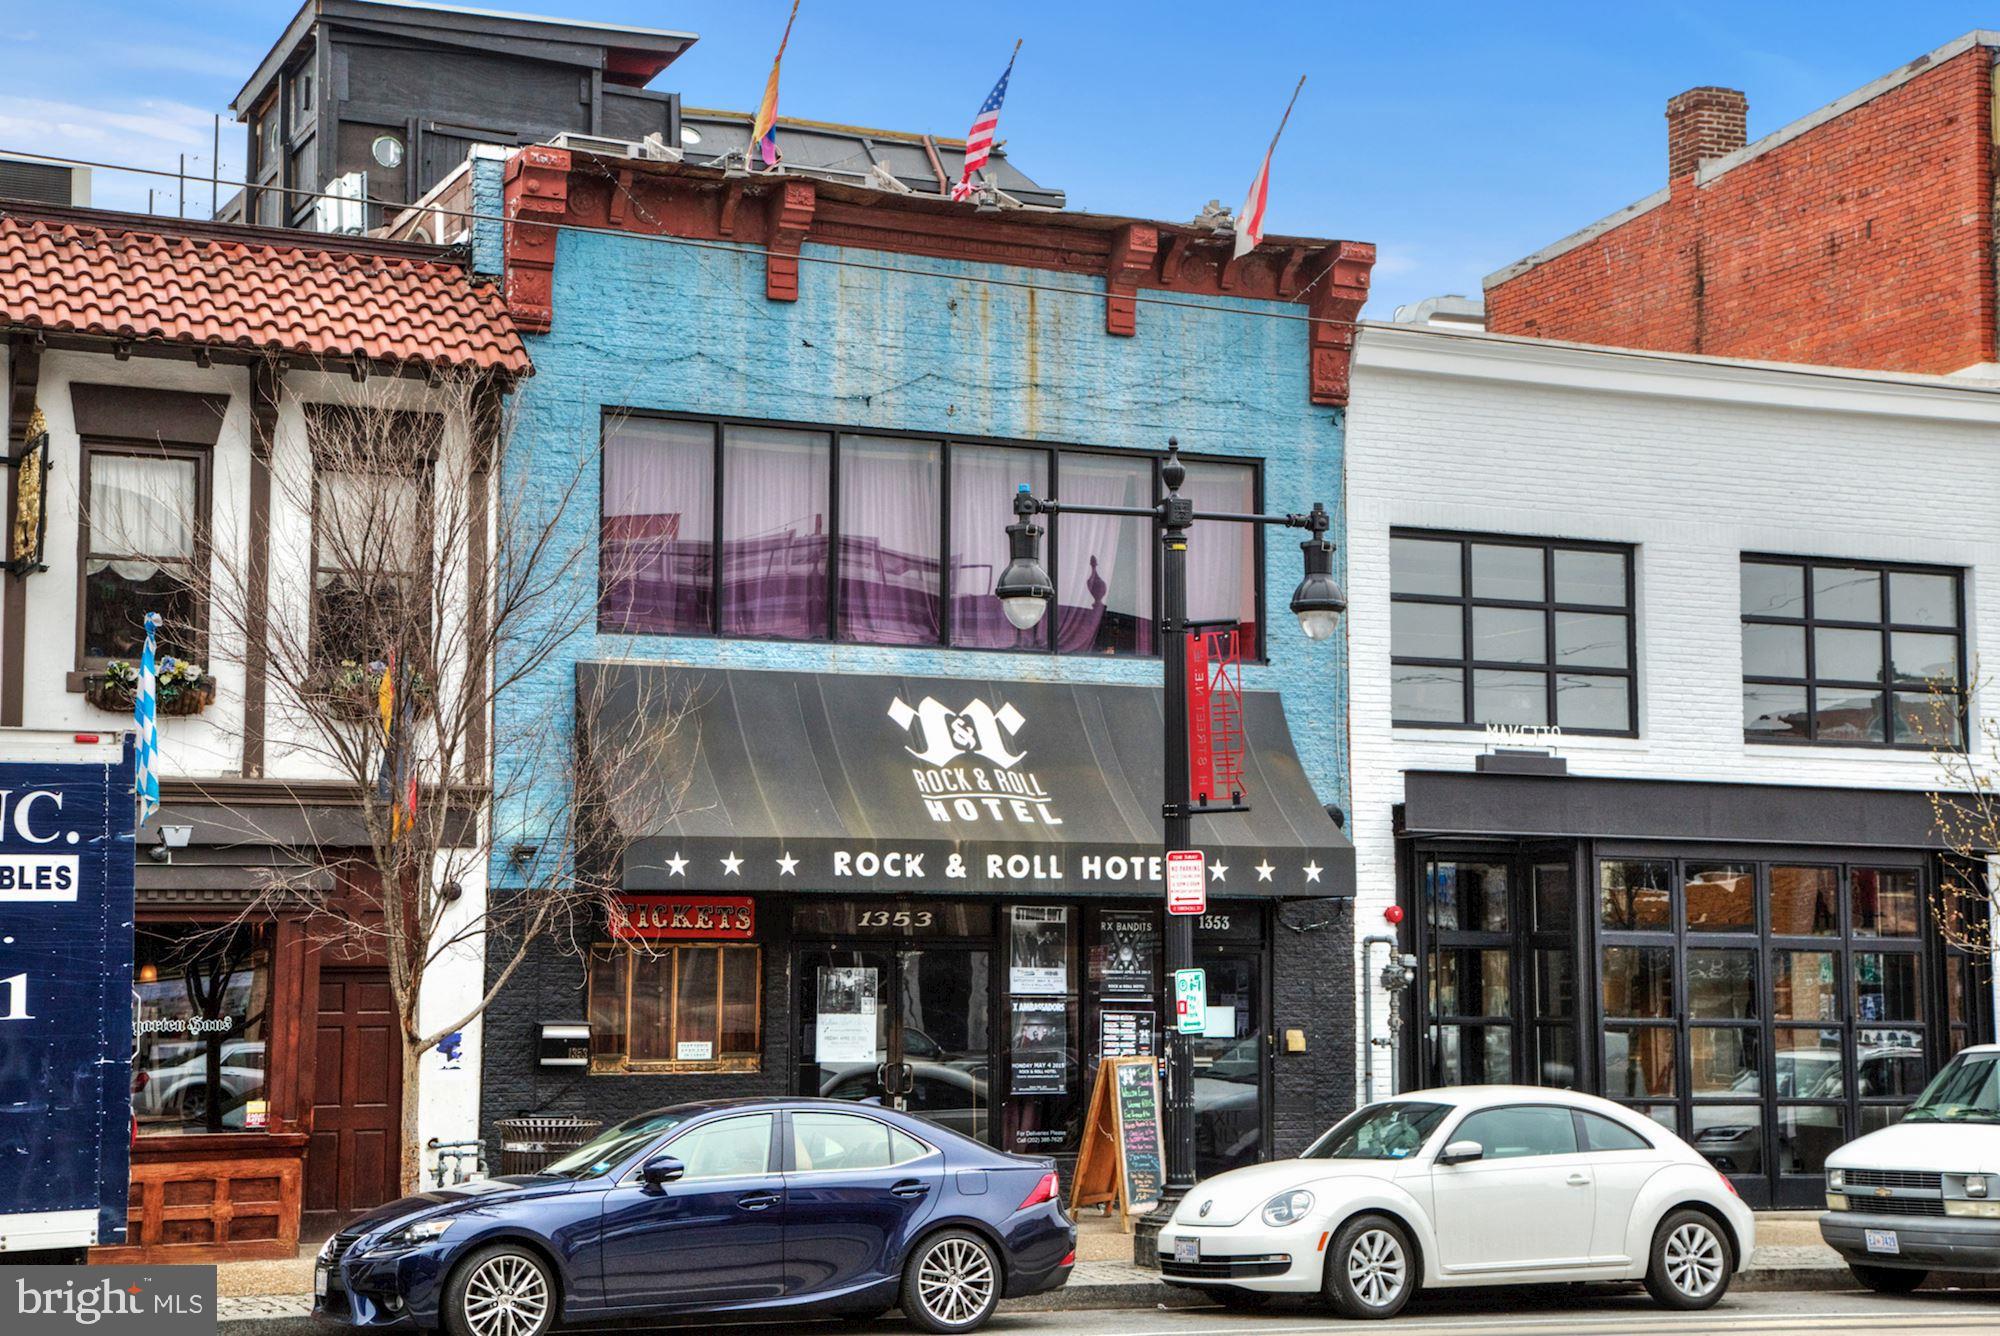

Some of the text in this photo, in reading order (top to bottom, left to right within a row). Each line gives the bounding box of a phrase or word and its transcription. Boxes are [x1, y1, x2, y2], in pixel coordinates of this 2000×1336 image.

[912, 768, 1048, 796] ROCK & ROLL
[924, 798, 1063, 825] HOTEL
[834, 851, 1162, 881] ROCK & ROLL HOTE
[617, 903, 751, 931] TICKETS
[857, 911, 933, 927] 1353
[1101, 922, 1152, 932] RX BANDITS
[1199, 915, 1230, 930] 1353
[1018, 1003, 1065, 1012] AMBASSADORS
[132, 1017, 186, 1037] garten
